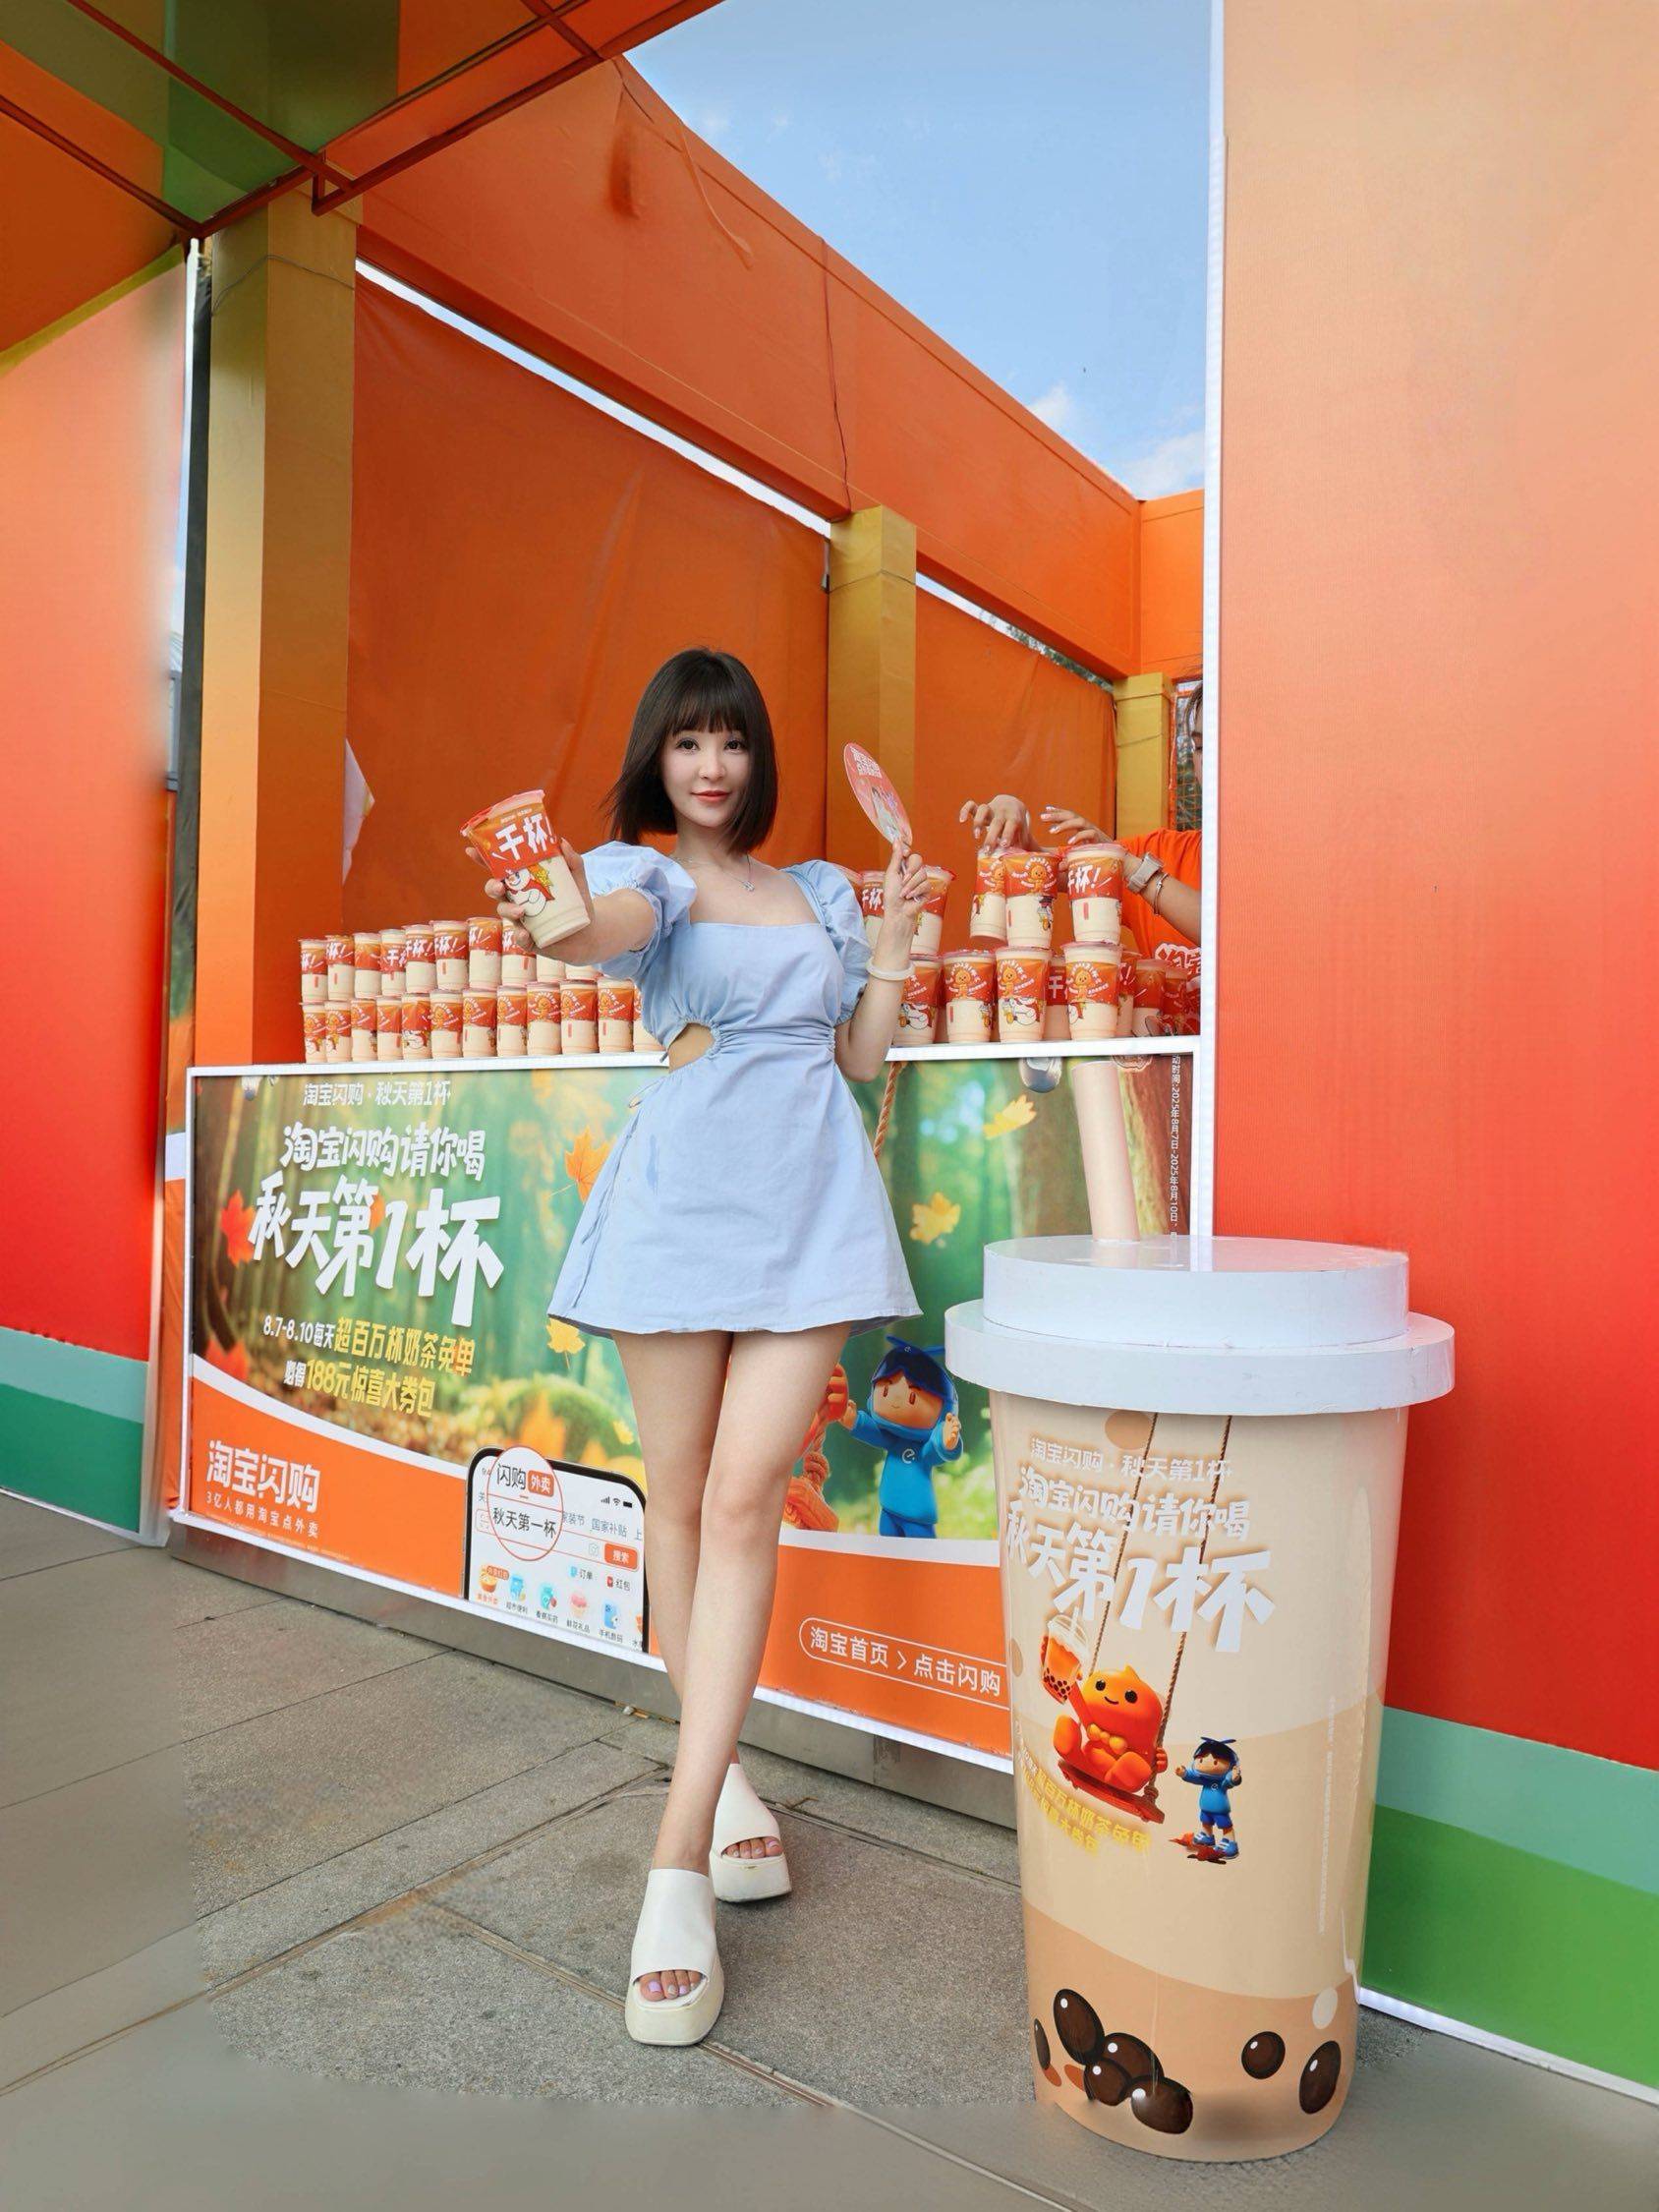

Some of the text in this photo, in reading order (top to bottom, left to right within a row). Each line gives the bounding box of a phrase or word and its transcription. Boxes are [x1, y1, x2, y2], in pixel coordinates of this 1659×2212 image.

[279, 1121, 486, 1182] 淘宝闪购请你喝
[248, 1170, 504, 1327] 秋天第1杯
[206, 1439, 321, 1513] 淘宝闪购
[496, 1463, 551, 1494] 闪购 外卖
[1018, 1465, 1251, 1542] 淘宝闪购请你喝
[205, 1490, 319, 1540] 3亿人都用淘宝点外卖
[492, 1507, 557, 1540] 秋天第一杯
[591, 1517, 628, 1540] 国家补贴
[615, 1580, 631, 1592] 红包
[1006, 1499, 1276, 1653] 秋天第1杯
[810, 1626, 1001, 1697] 淘宝首页 点击闪购
